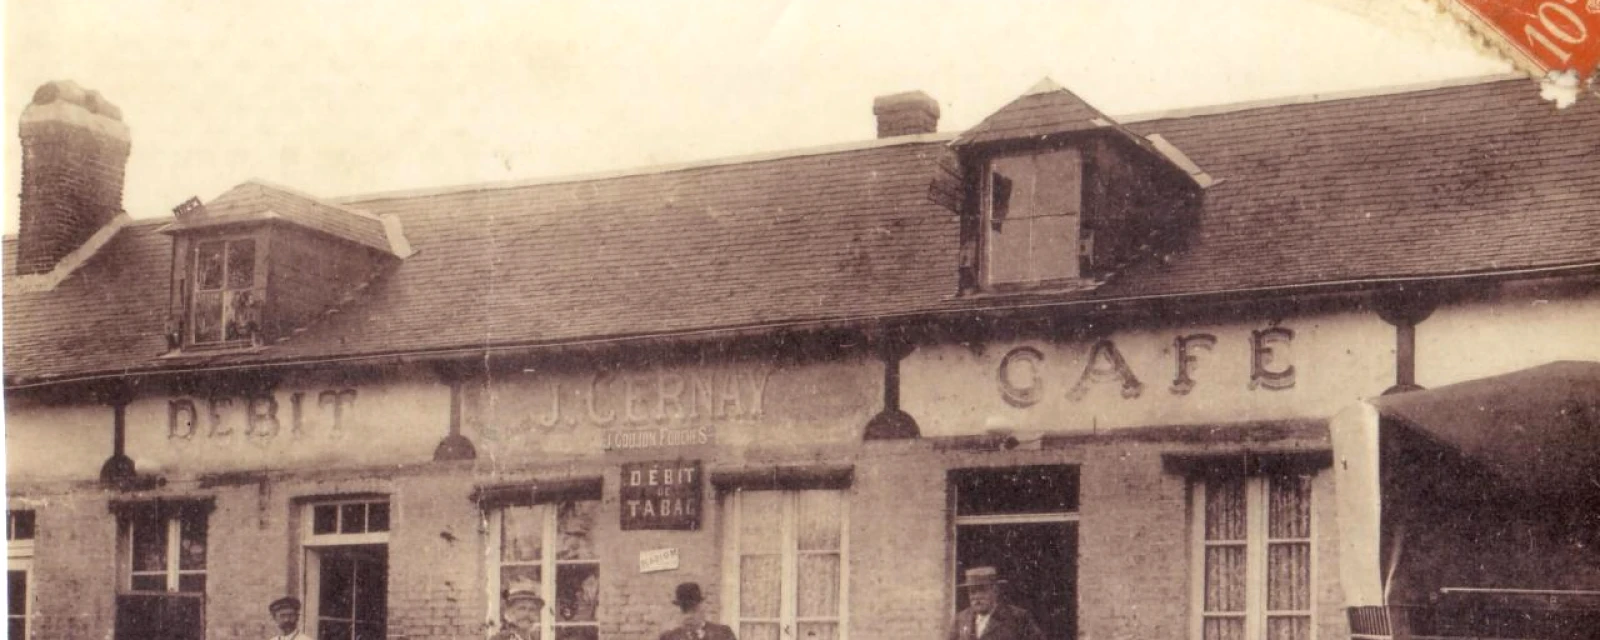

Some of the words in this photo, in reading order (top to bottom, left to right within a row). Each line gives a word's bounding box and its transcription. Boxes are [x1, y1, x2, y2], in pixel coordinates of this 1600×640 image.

[586, 368, 771, 425] CERNAY
[630, 464, 694, 486] DÉBIT
[627, 499, 696, 517] TABAC
